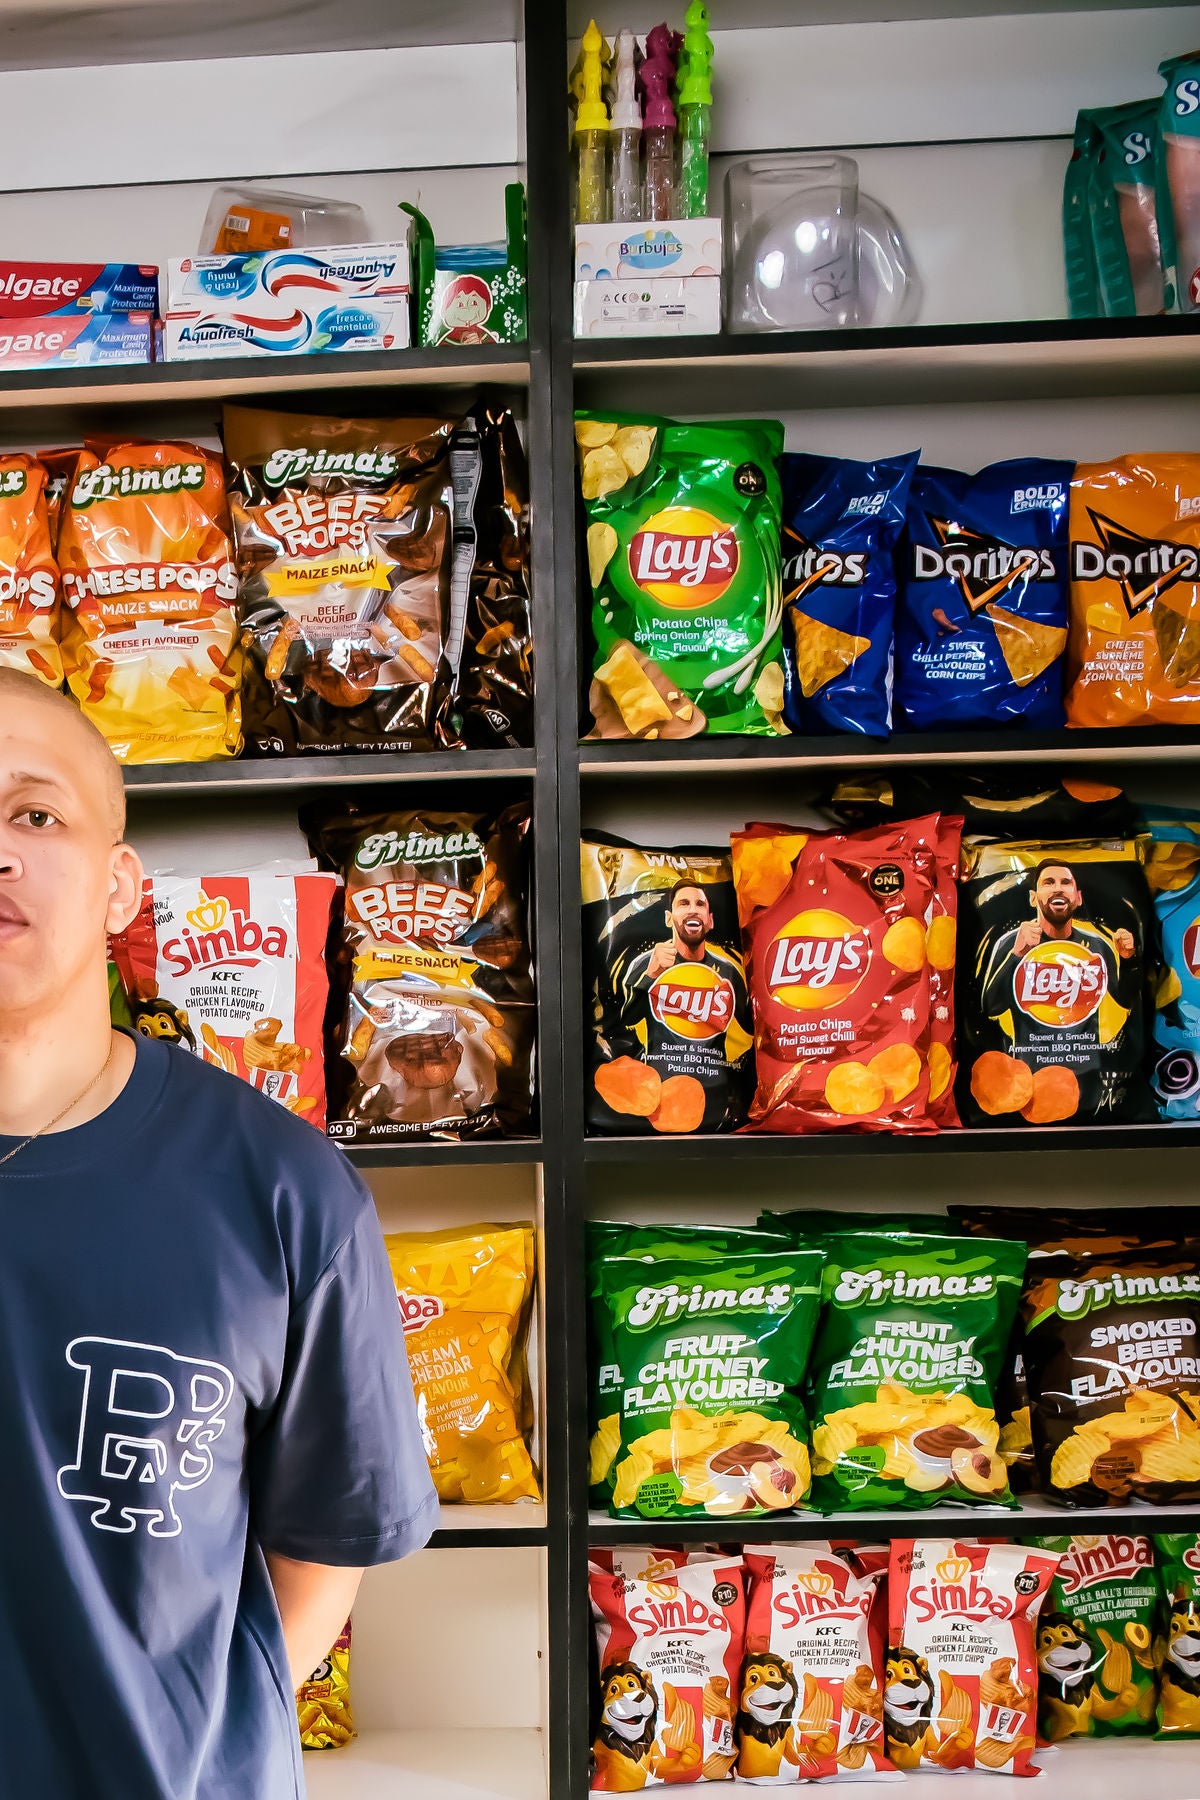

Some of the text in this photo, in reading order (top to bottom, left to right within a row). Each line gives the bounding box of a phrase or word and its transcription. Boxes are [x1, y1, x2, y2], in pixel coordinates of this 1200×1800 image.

[620, 241, 683, 257] Burbujas
[319, 262, 395, 280] Aquafresh
[114, 284, 157, 294] Maximum
[132, 292, 155, 301] Cavity
[111, 299, 156, 309] Protection
[328, 321, 380, 332] mentolado
[101, 332, 149, 344] Maximum
[178, 325, 254, 345] Aquafresh
[71, 463, 205, 508] Frimax
[1013, 485, 1060, 502] BOLD
[1012, 498, 1062, 512] CRUNCH
[636, 530, 732, 588] Lay's
[915, 544, 1056, 582] Doritos
[286, 561, 375, 581] MAIZE SNACK
[317, 604, 346, 616] BEEF
[300, 612, 358, 624] FLAVOURED
[652, 615, 729, 630] Potato Chips
[673, 641, 711, 653] Flavour
[948, 641, 985, 651] SWEET
[1104, 640, 1144, 650] CHEESE
[1095, 650, 1145, 661] SUPREME
[926, 671, 987, 681] CORN CHIPS
[377, 741, 413, 750] TASTE!
[873, 875, 900, 887] ONE
[369, 914, 455, 943] POPS
[162, 912, 289, 978] Simba
[770, 932, 865, 989] Lay's
[210, 971, 242, 982] KFC
[190, 985, 260, 999] ORIGINAL RECIPE
[185, 996, 265, 1013] CHICKEN FLAVOURED
[200, 1008, 251, 1021] POTATO CHIPS
[777, 1030, 856, 1048] Thai Sweet Chilli
[796, 1044, 836, 1057] Flavour
[1008, 1040, 1118, 1054] American BBQ Flavoured
[1036, 1053, 1091, 1064] Potato Chips
[668, 1063, 720, 1077] Potato Chips
[834, 1268, 993, 1303] Frimax
[627, 1284, 792, 1327] Frimax
[874, 1320, 953, 1342] FRUIT
[1090, 1317, 1197, 1349] SMOKED
[664, 1334, 746, 1359] FRUIT
[850, 1335, 978, 1362] CHUTNEY
[1117, 1338, 1183, 1365] BEEF
[638, 1357, 770, 1384] CHUTNEY
[909, 1577, 1013, 1624] Simba
[628, 1597, 729, 1637] Simba
[815, 1626, 842, 1636] KFC
[666, 1639, 694, 1648] KFC
[796, 1638, 859, 1650] ORIGINAL RECIPE
[924, 1644, 998, 1656] CHICKEN FLAVOURED
[803, 1657, 851, 1667] POTATO CHIPS
